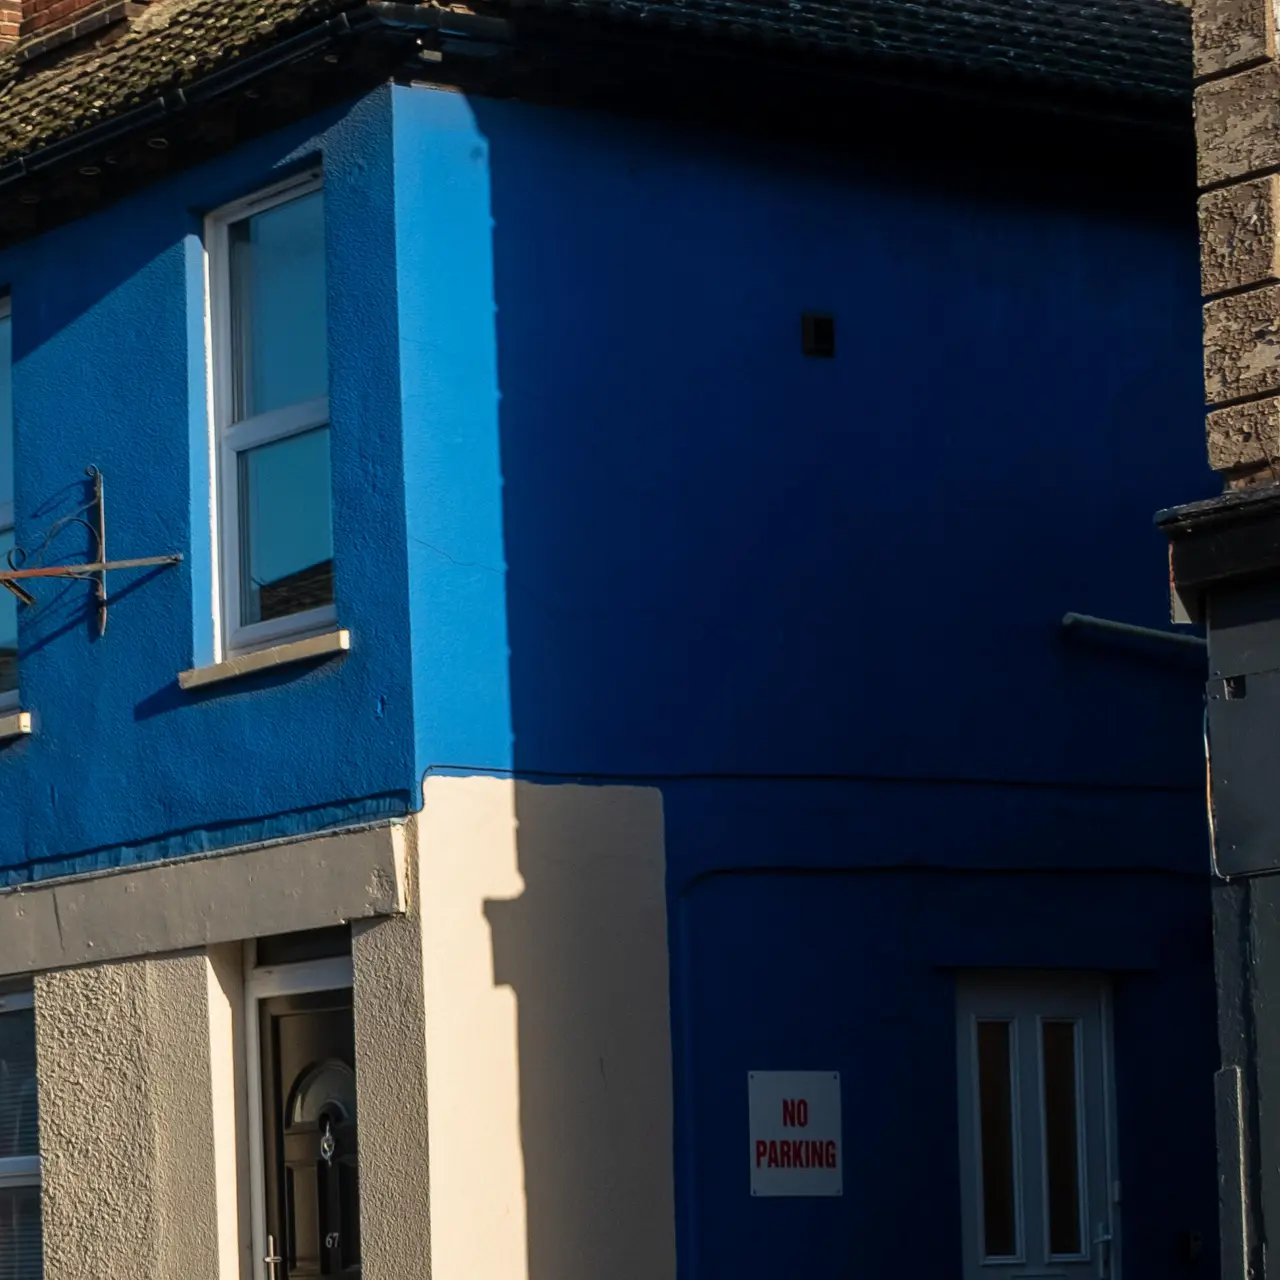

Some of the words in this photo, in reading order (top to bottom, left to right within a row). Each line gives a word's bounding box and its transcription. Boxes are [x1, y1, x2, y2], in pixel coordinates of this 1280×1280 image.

[782, 1098, 808, 1128] NO
[755, 1139, 837, 1169] PARKING
[325, 1232, 339, 1248] 67
